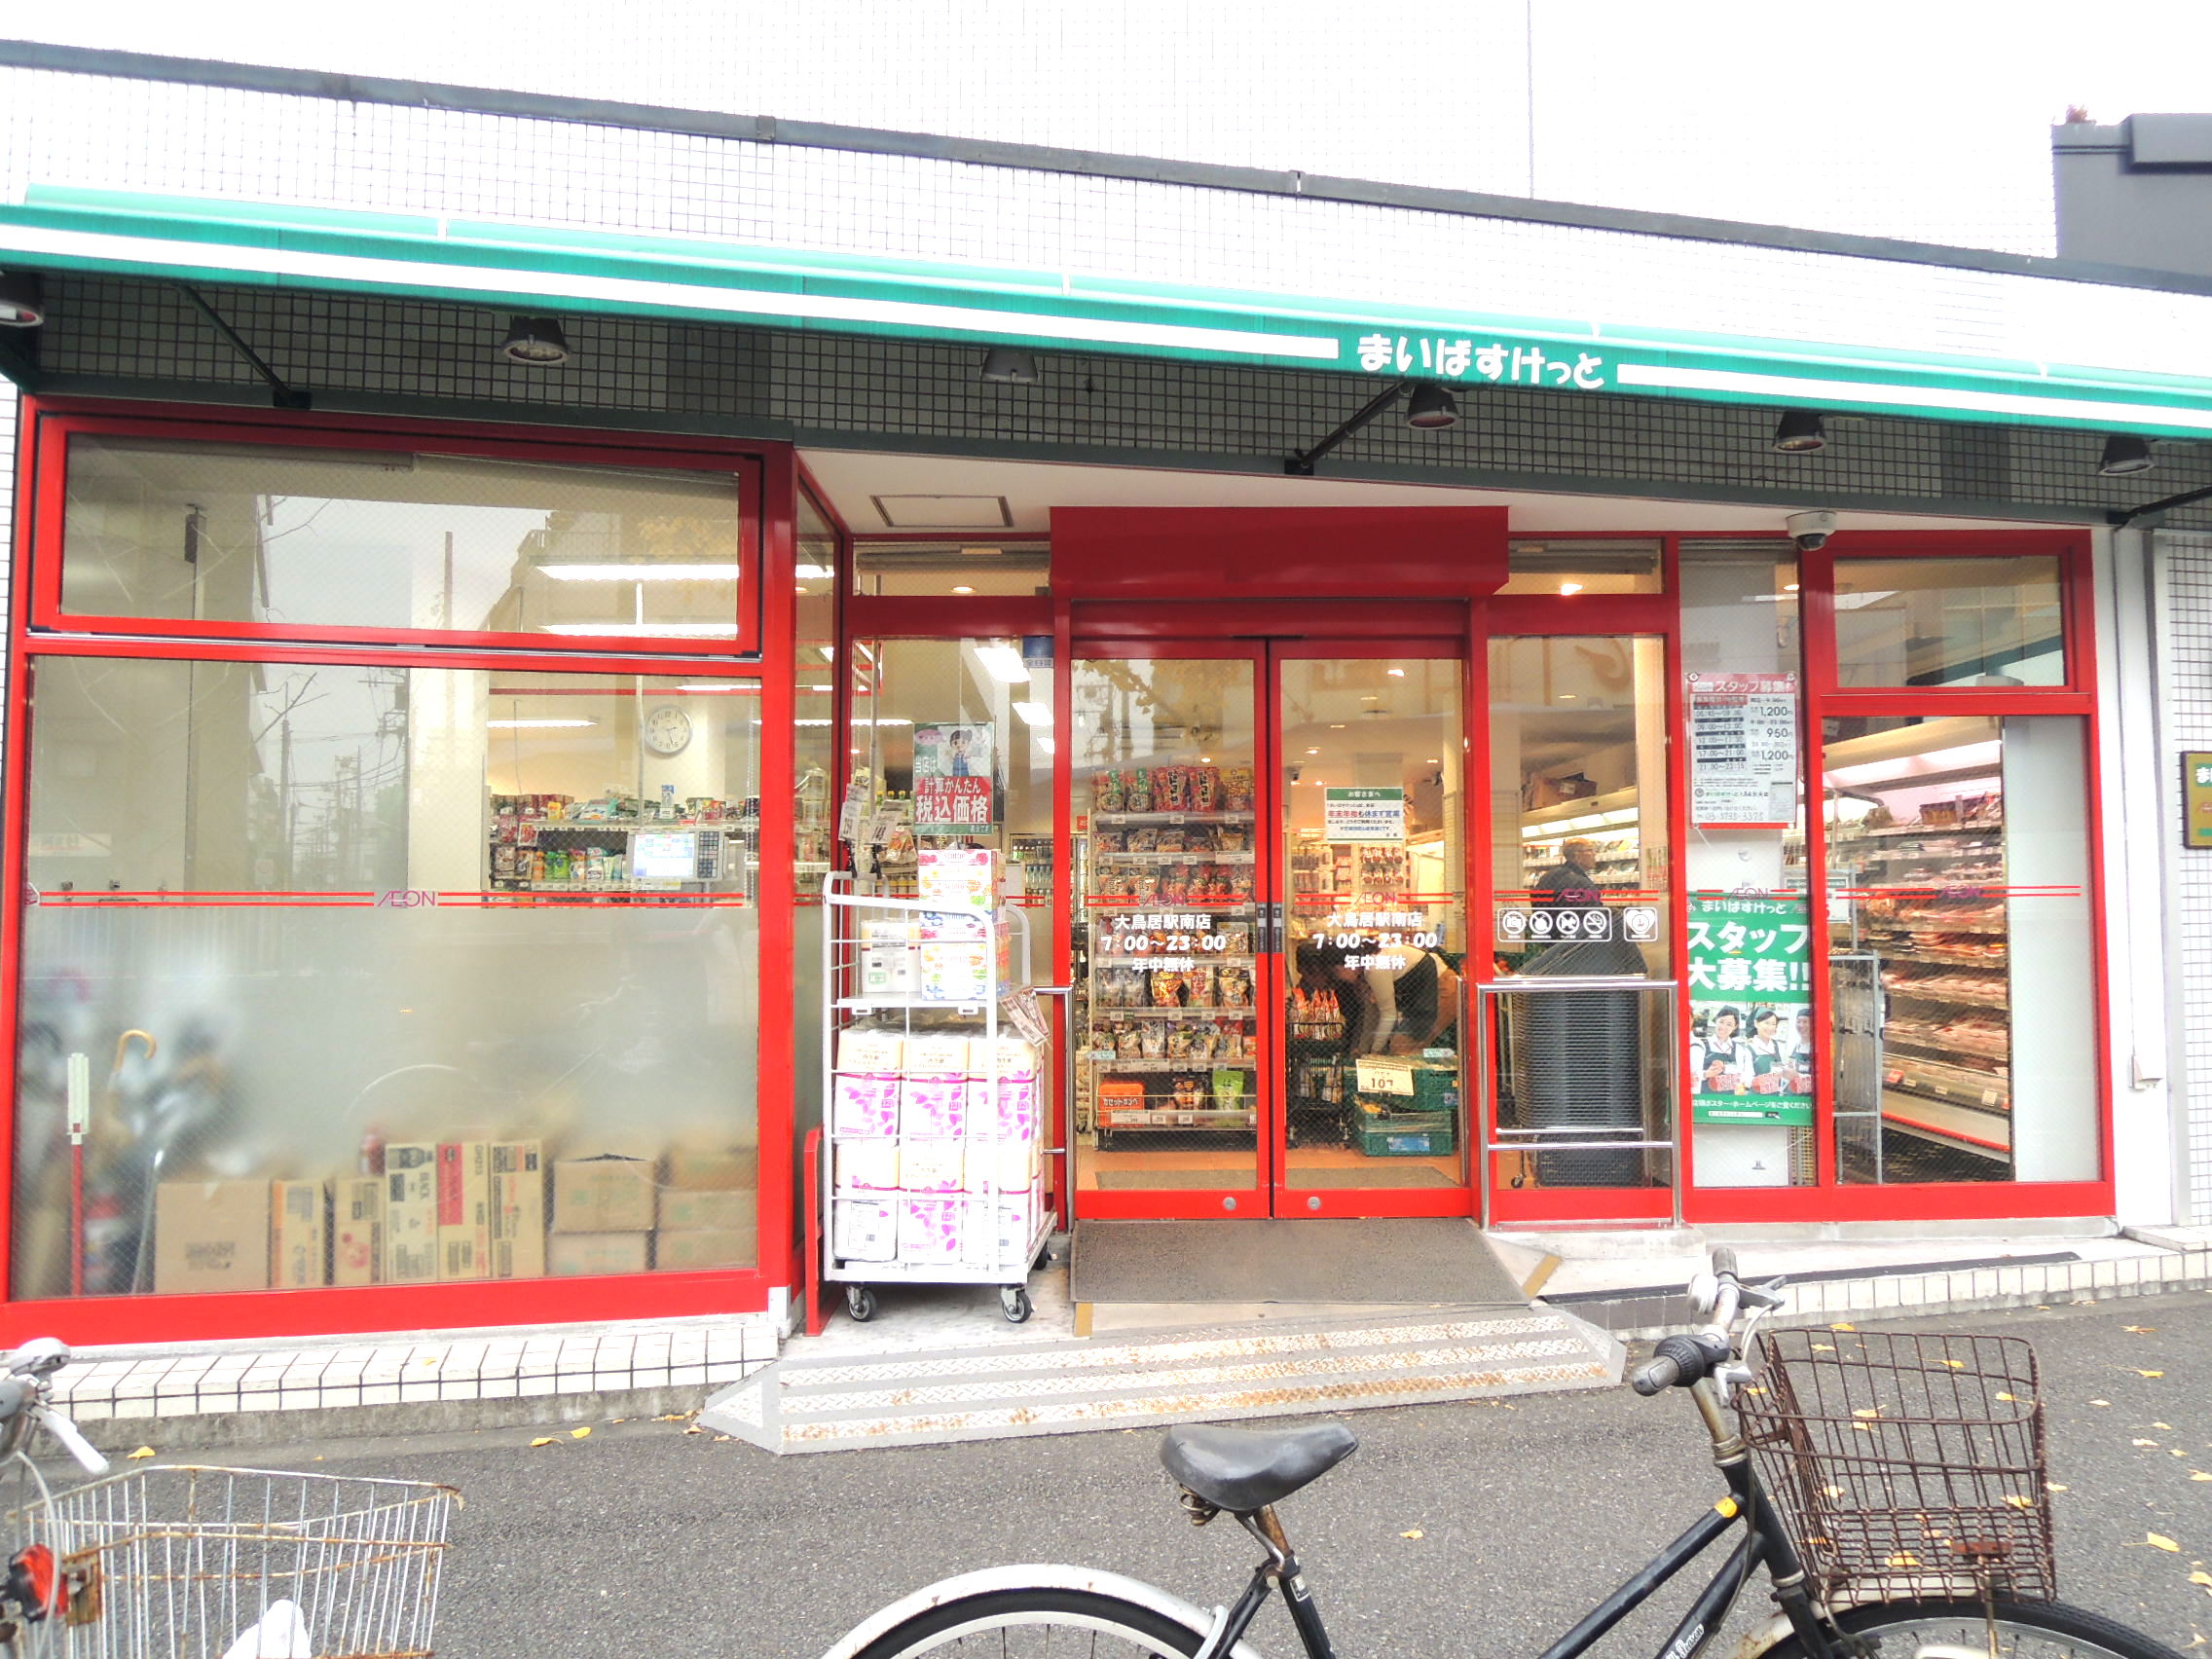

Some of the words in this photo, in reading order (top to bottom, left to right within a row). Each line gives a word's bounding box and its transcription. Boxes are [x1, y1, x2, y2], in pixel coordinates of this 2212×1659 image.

[1357, 333, 1604, 389] まいばすけっと
[925, 778, 981, 794] 計算かんたん
[916, 794, 988, 823] 税込価格
[1702, 901, 1787, 914] まいばすけっと
[1115, 914, 1211, 930] 大鳥居駅南店
[1326, 911, 1422, 927] 大鳥居駅南店
[1687, 920, 1808, 954] スタッフ
[1132, 957, 1195, 973] 年中無休
[1345, 955, 1406, 970] 年中無休
[1688, 956, 1810, 992] 大募集!!
